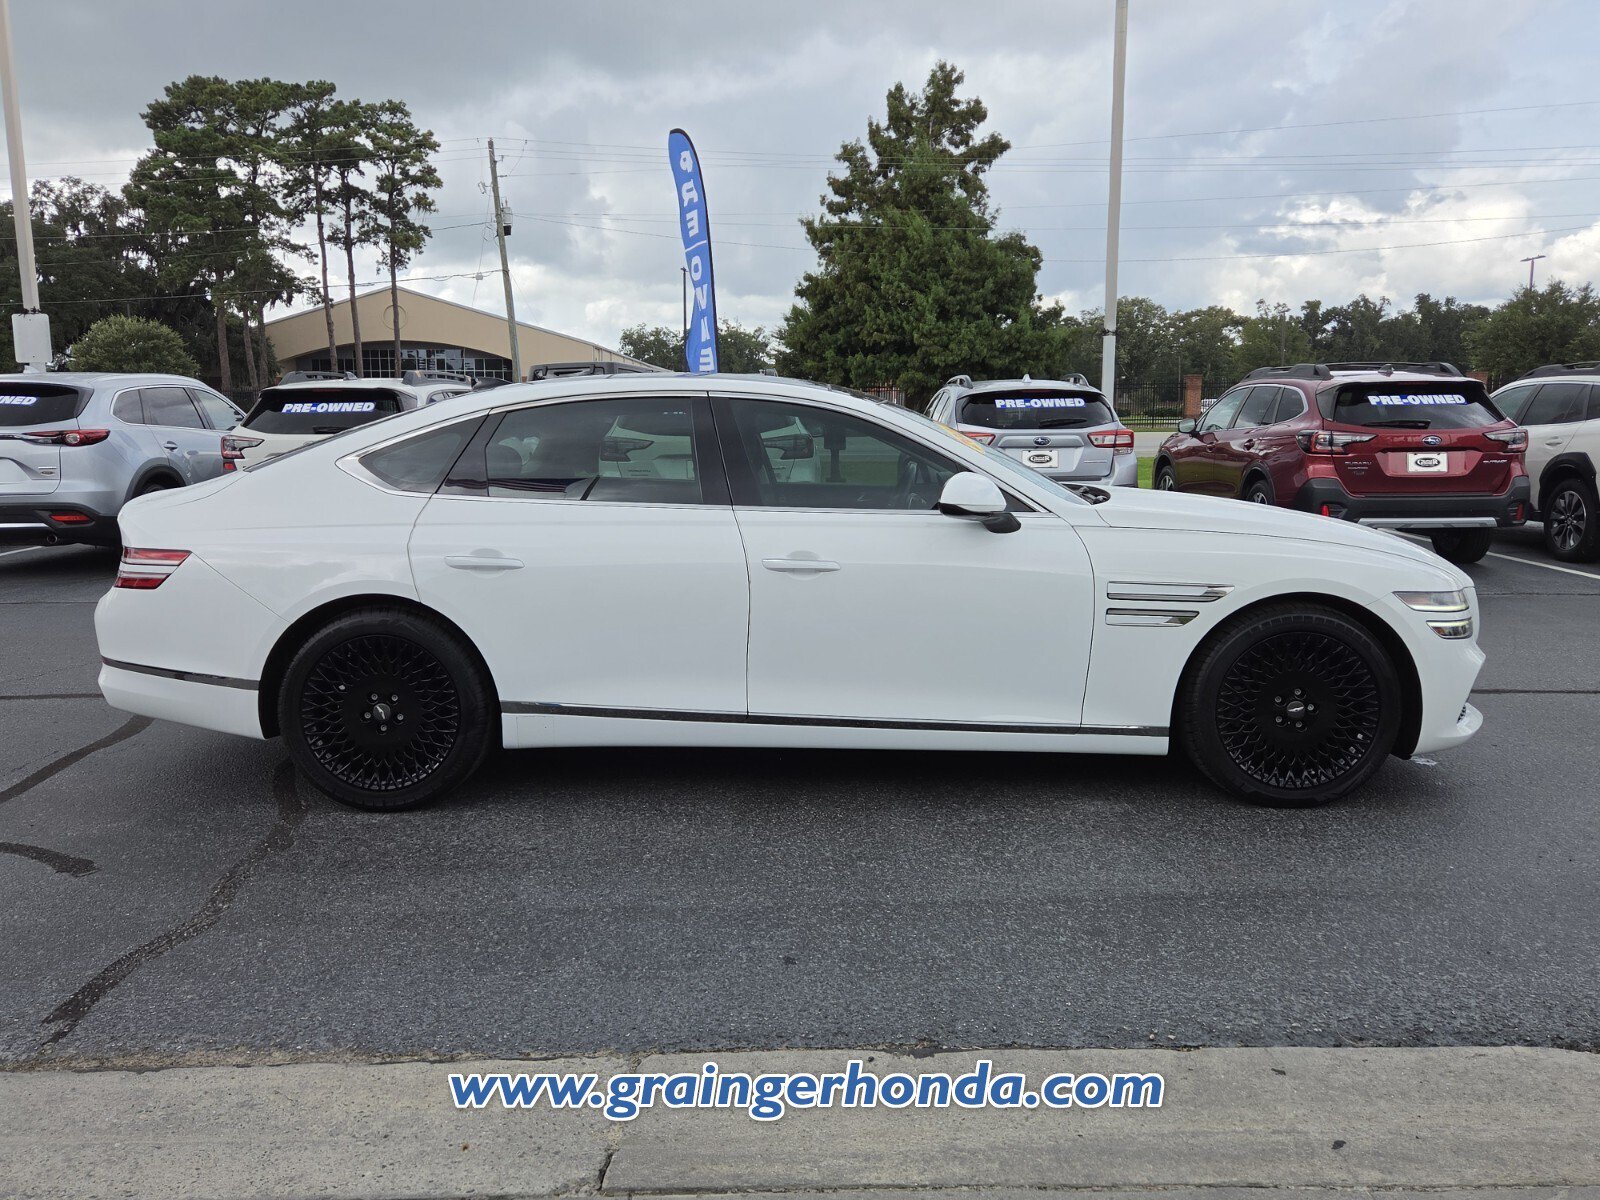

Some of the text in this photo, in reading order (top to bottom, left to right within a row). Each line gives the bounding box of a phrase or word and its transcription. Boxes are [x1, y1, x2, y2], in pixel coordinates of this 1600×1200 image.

[994, 398, 1085, 408] PRE-OWNED
[1367, 395, 1466, 405] PRE-OWNED
[281, 402, 376, 413] PRE-OWNED
